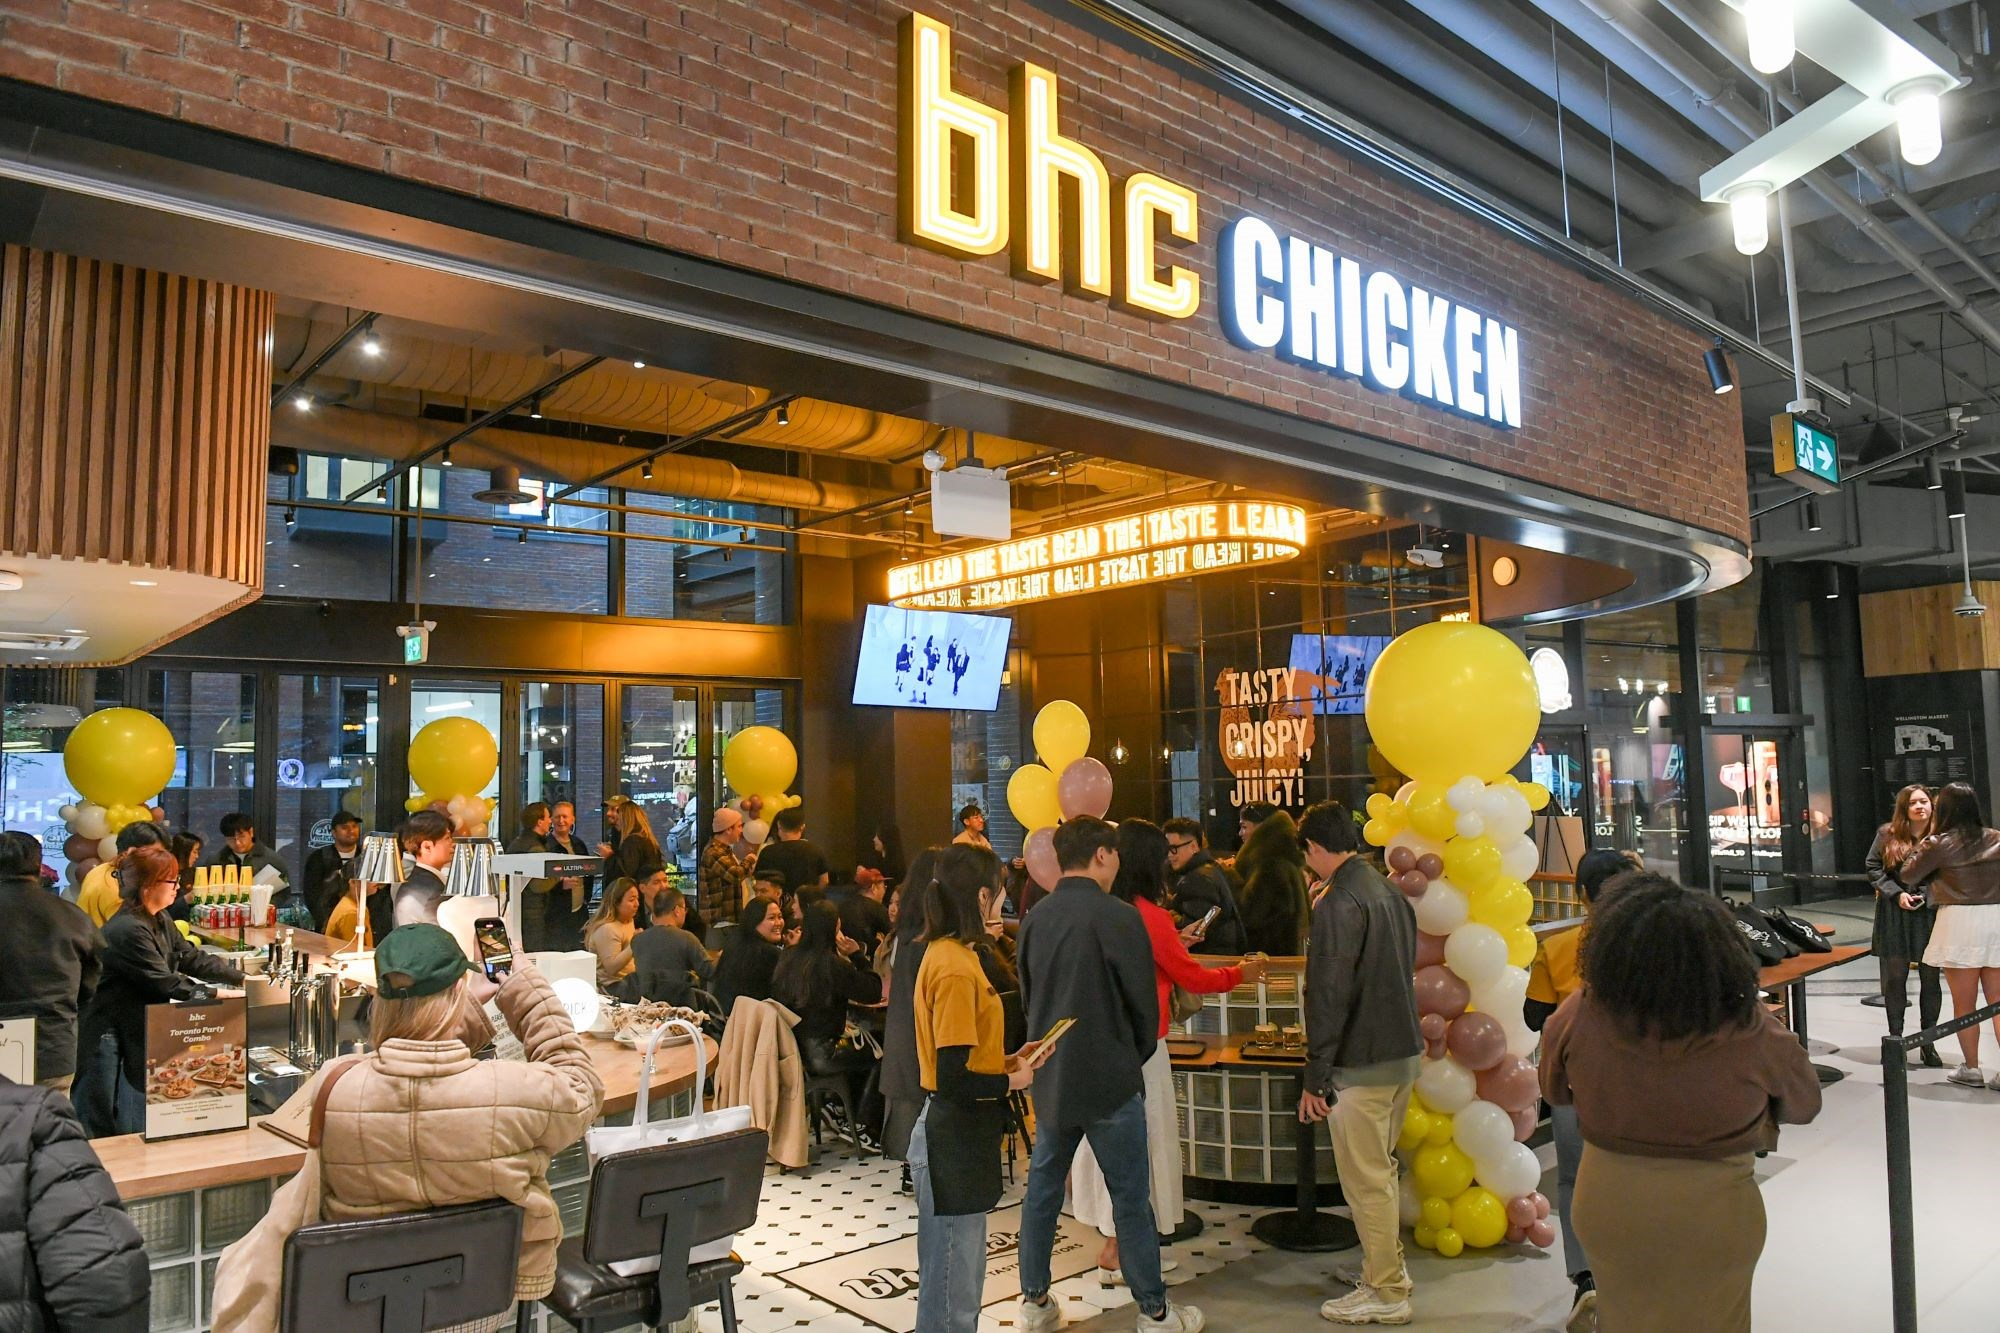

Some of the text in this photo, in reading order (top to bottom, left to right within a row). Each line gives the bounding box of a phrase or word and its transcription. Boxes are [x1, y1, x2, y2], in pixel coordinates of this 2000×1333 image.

[910, 11, 1522, 429] bhc CHICKEN
[924, 556, 962, 588] LEAD
[965, 548, 997, 579] THE
[1000, 536, 1048, 571] TASTE
[1052, 526, 1100, 563] READ
[1104, 517, 1142, 553] THE
[1148, 504, 1218, 544] TASTE
[1226, 666, 1297, 709] TASTY
[1225, 718, 1312, 762] CRISPY,
[1230, 767, 1305, 807] JUICY!
[1709, 815, 1726, 828] SIP
[170, 1025, 225, 1037] Toronto Party
[189, 1013, 206, 1022] bhc
[183, 1035, 212, 1044] Combo
